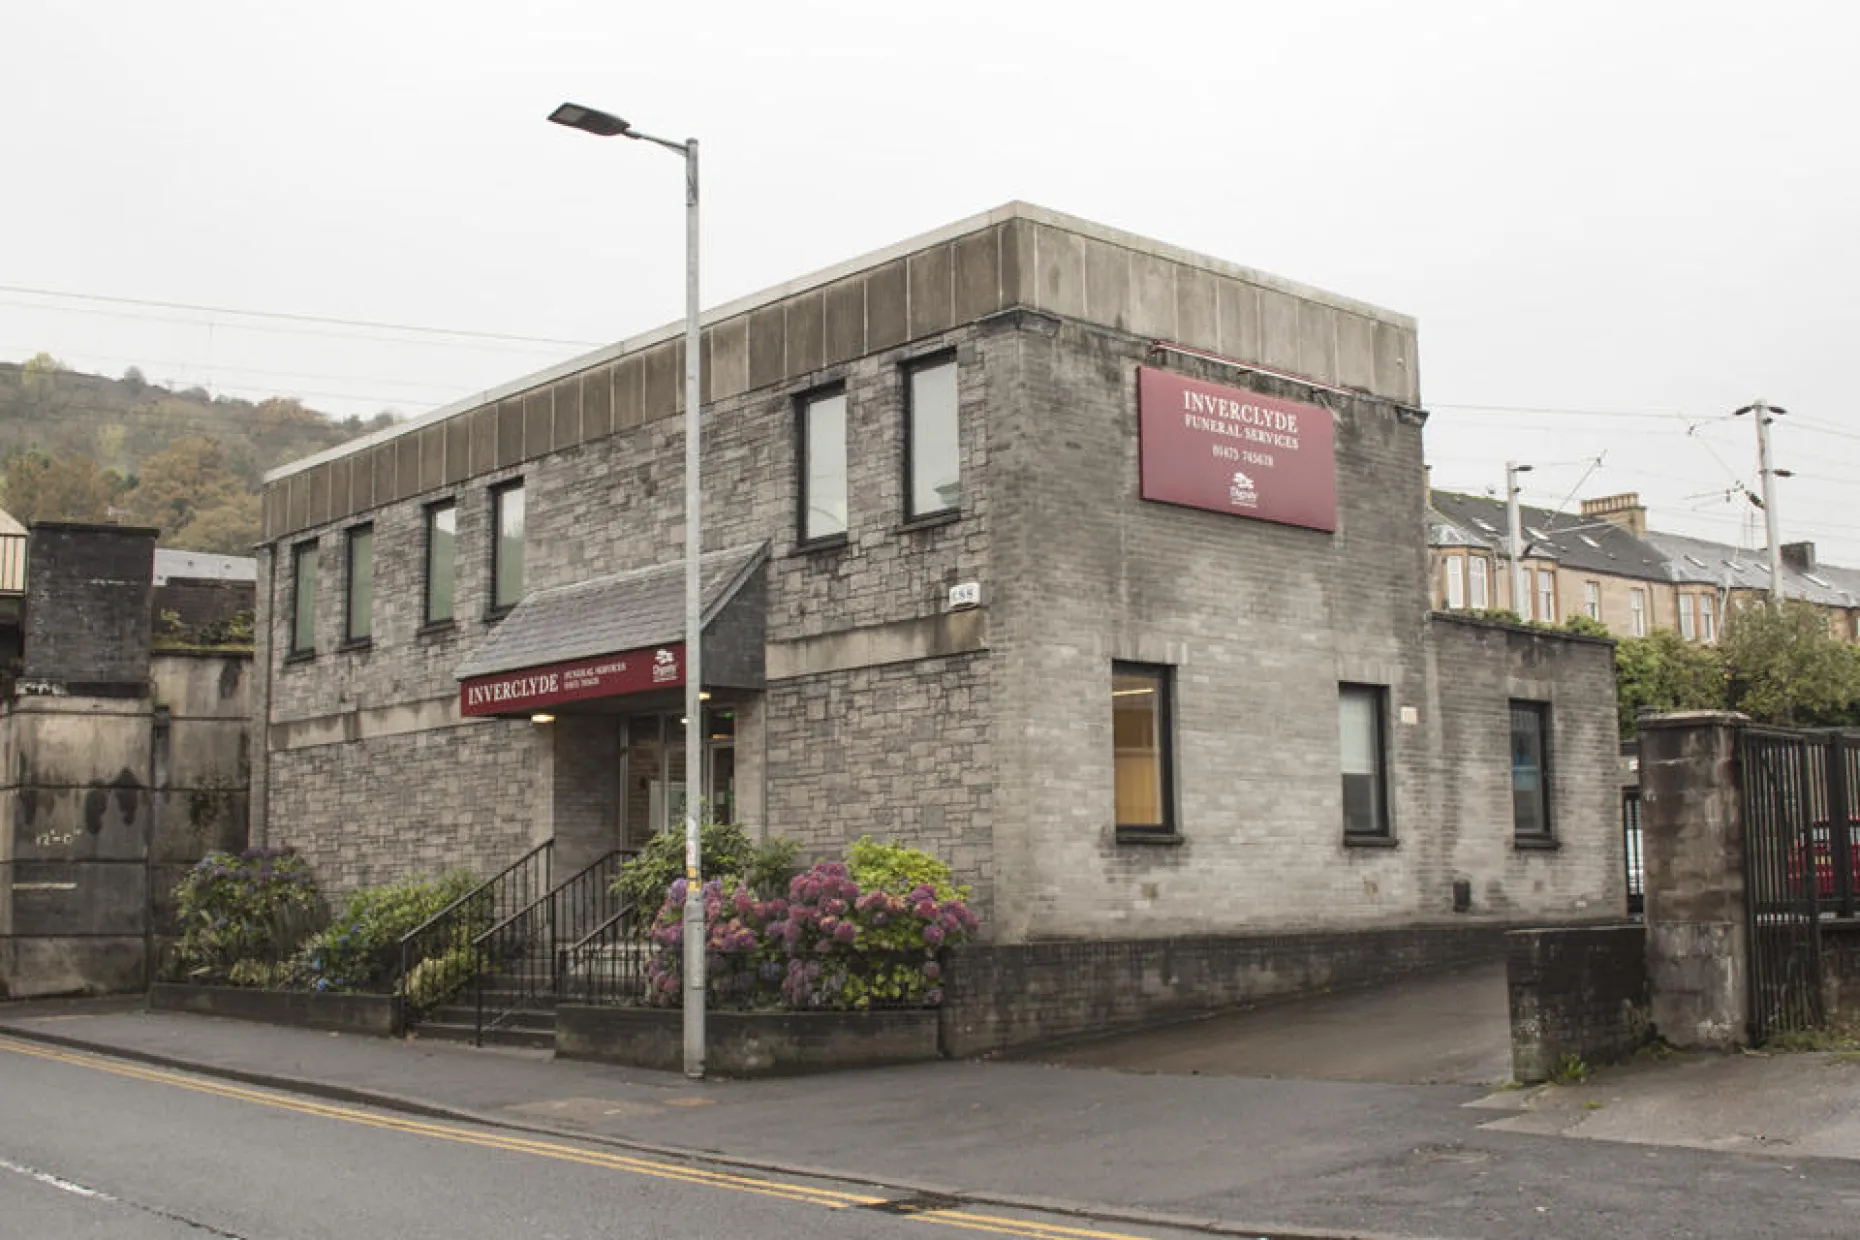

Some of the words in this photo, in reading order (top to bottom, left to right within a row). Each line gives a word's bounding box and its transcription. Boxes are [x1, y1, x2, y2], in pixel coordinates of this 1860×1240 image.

[1183, 390, 1298, 433] INVERCLYDE
[1184, 413, 1242, 438] FUNERAL
[1244, 427, 1299, 450] SERVICES
[468, 673, 559, 705] INVERCLYDE
